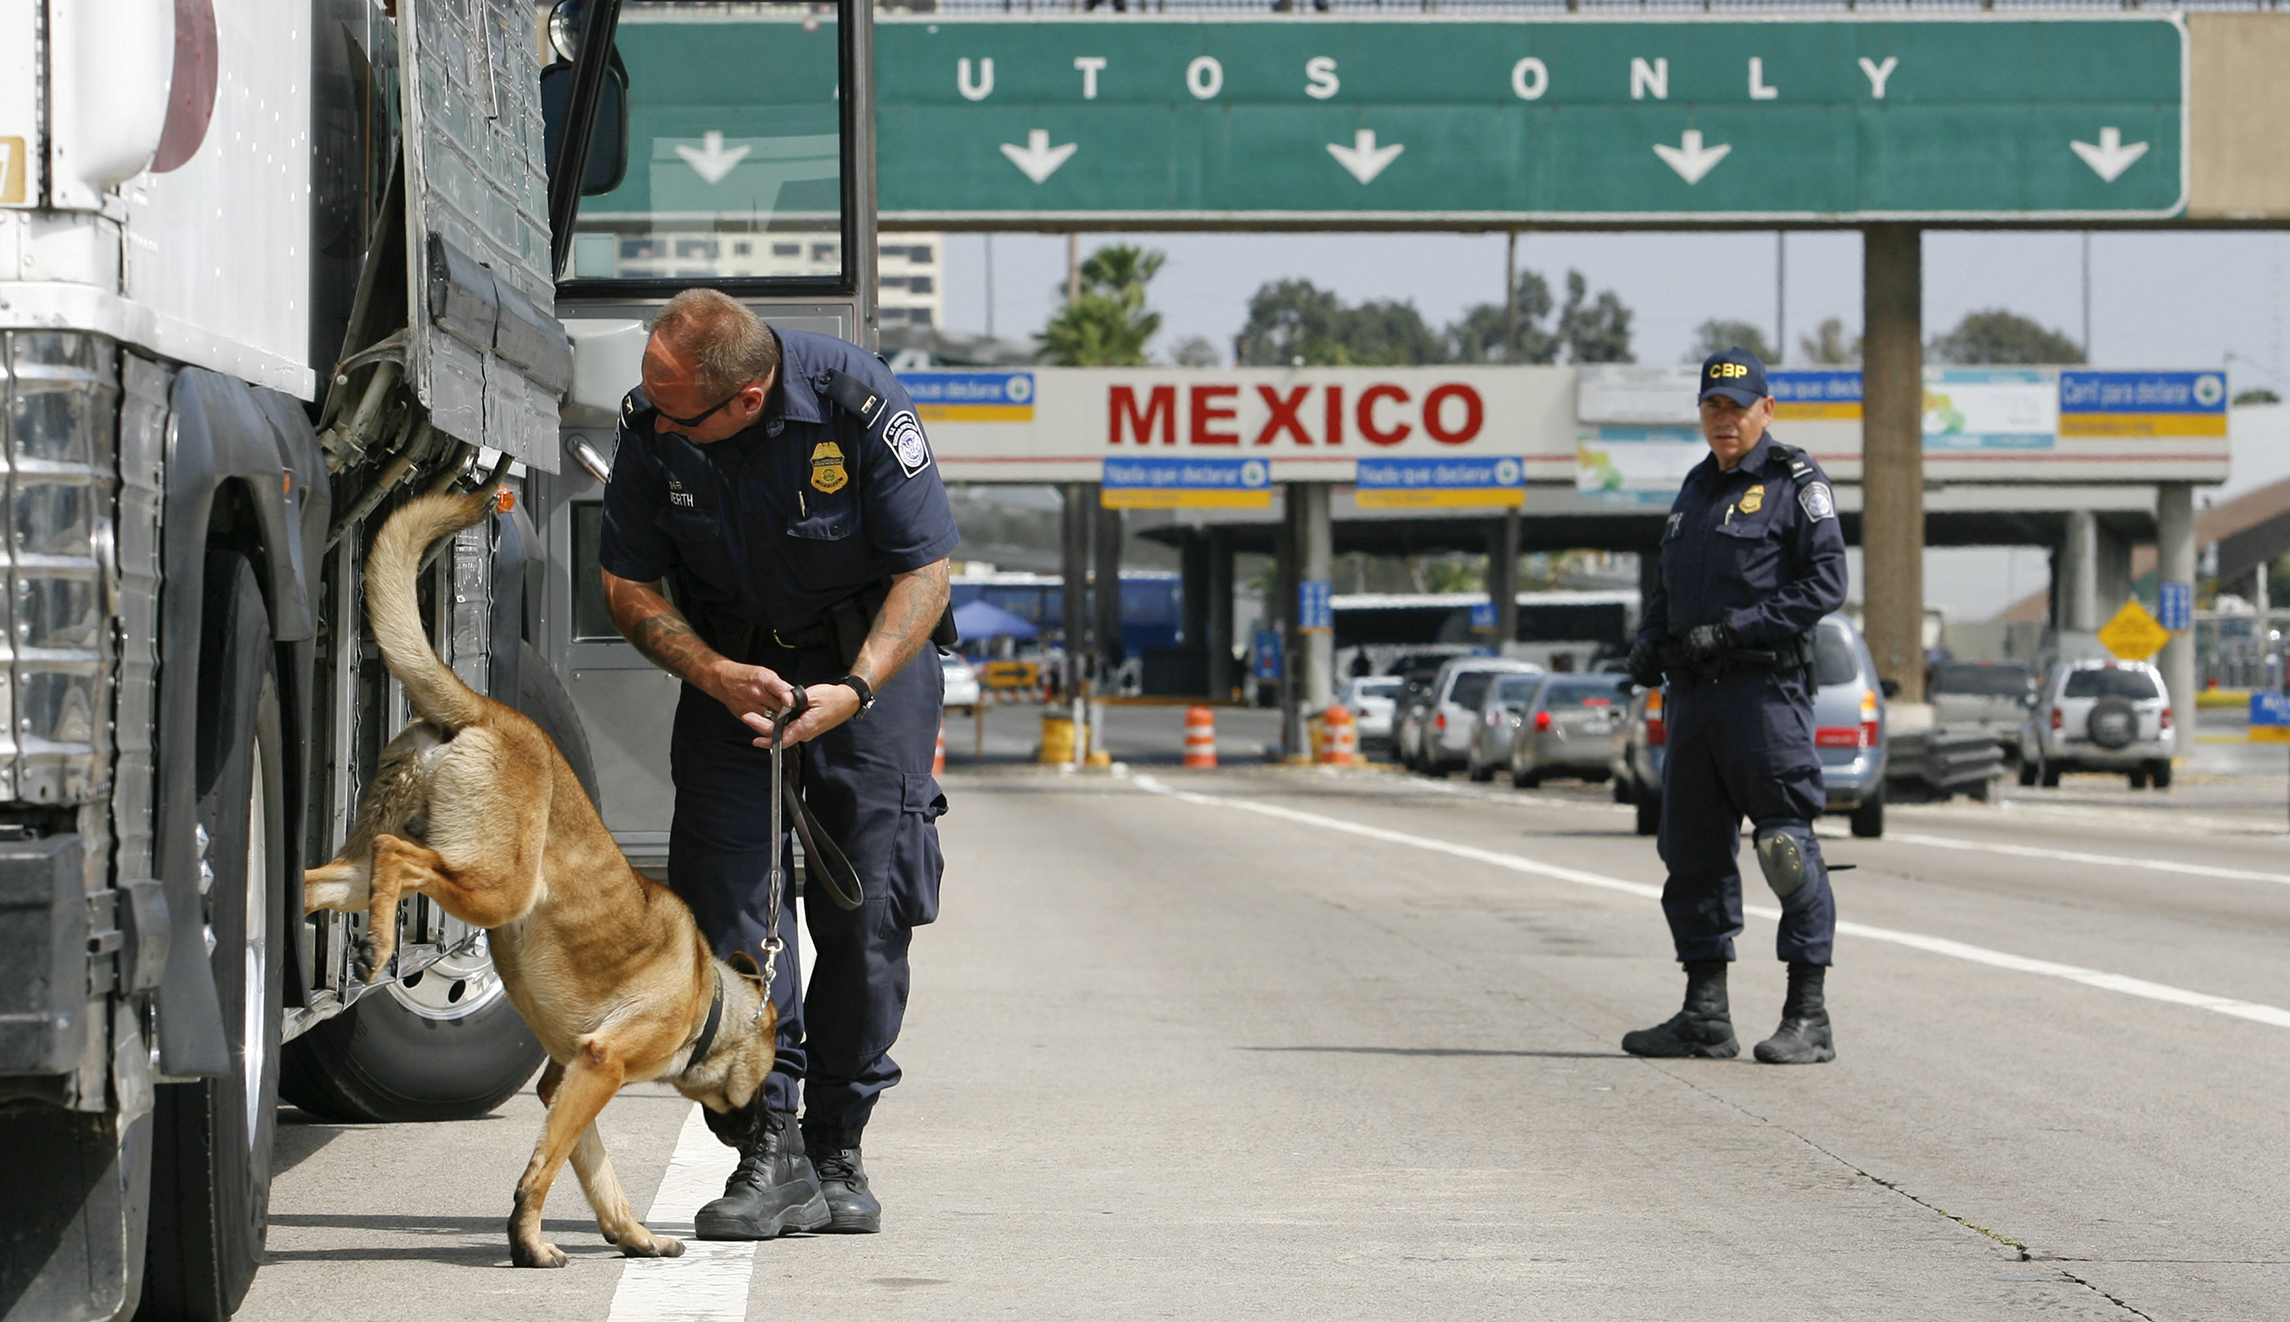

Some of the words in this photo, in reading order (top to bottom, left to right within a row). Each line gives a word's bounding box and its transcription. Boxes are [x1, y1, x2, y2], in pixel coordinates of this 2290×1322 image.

[833, 55, 1340, 101] UTOS
[1510, 55, 1899, 101] ONLY
[1709, 362, 1749, 379] CBP
[1108, 383, 1484, 446] MEXICO
